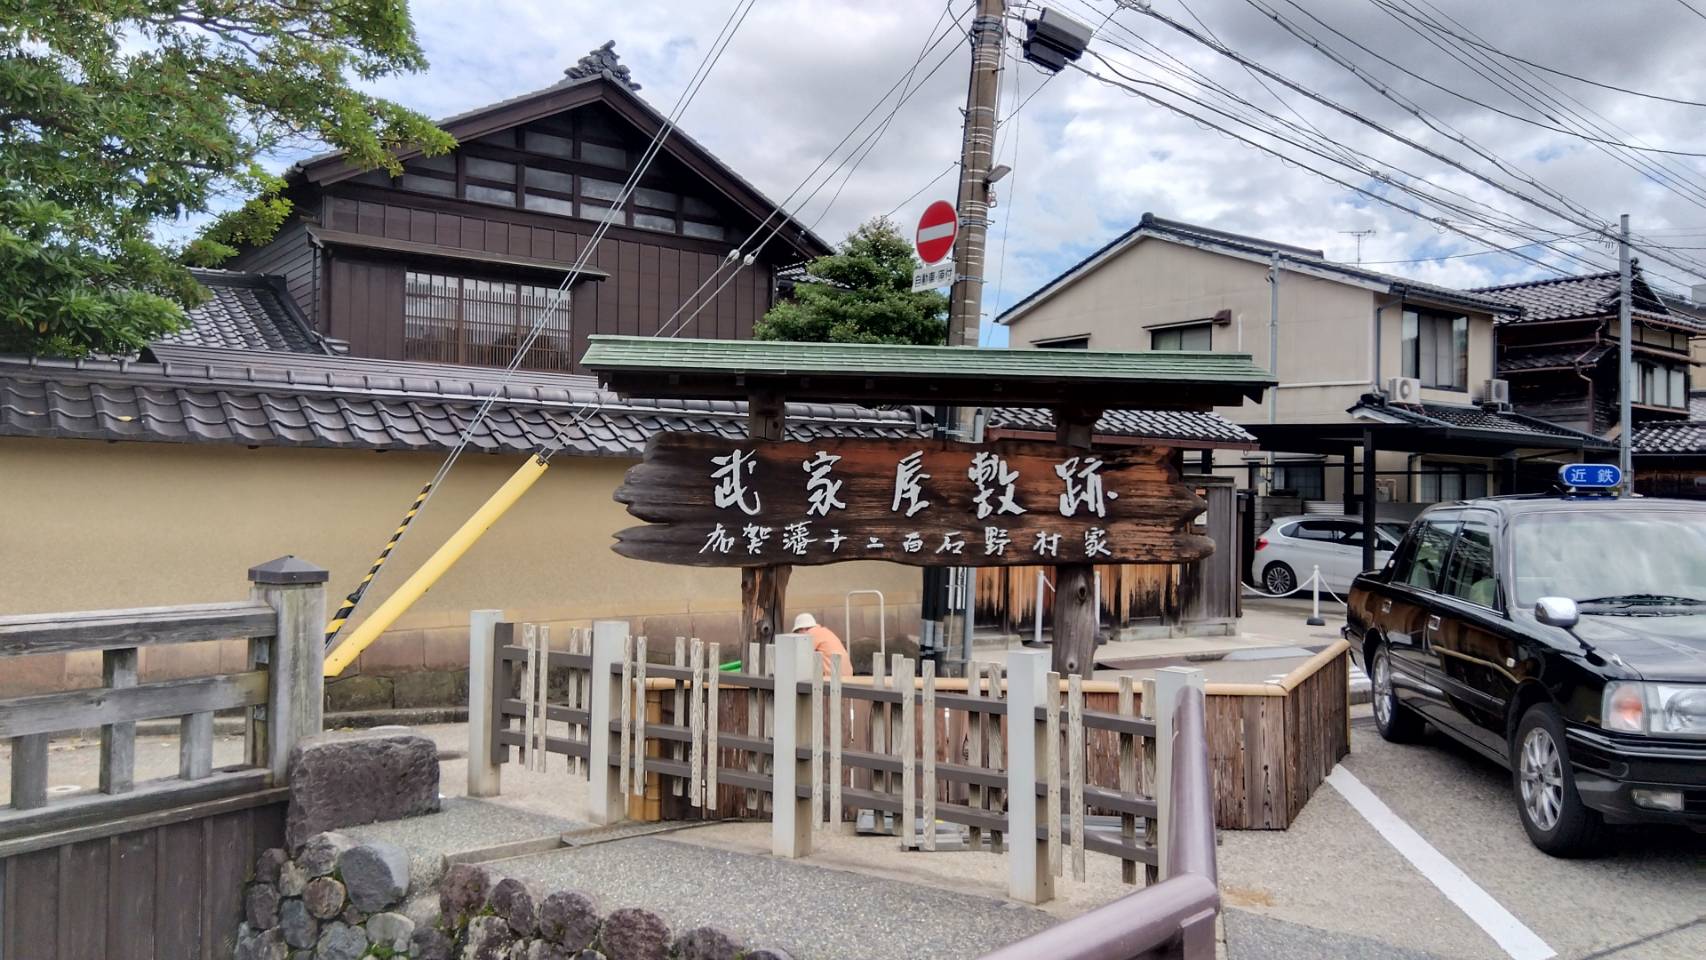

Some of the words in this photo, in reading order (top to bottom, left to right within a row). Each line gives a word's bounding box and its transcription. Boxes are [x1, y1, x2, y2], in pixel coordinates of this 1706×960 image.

[709, 449, 1118, 519] 武家屋敷跡
[1571, 468, 1614, 483] 近鉄
[699, 521, 1112, 558] 加賀藩千二百石野村家
